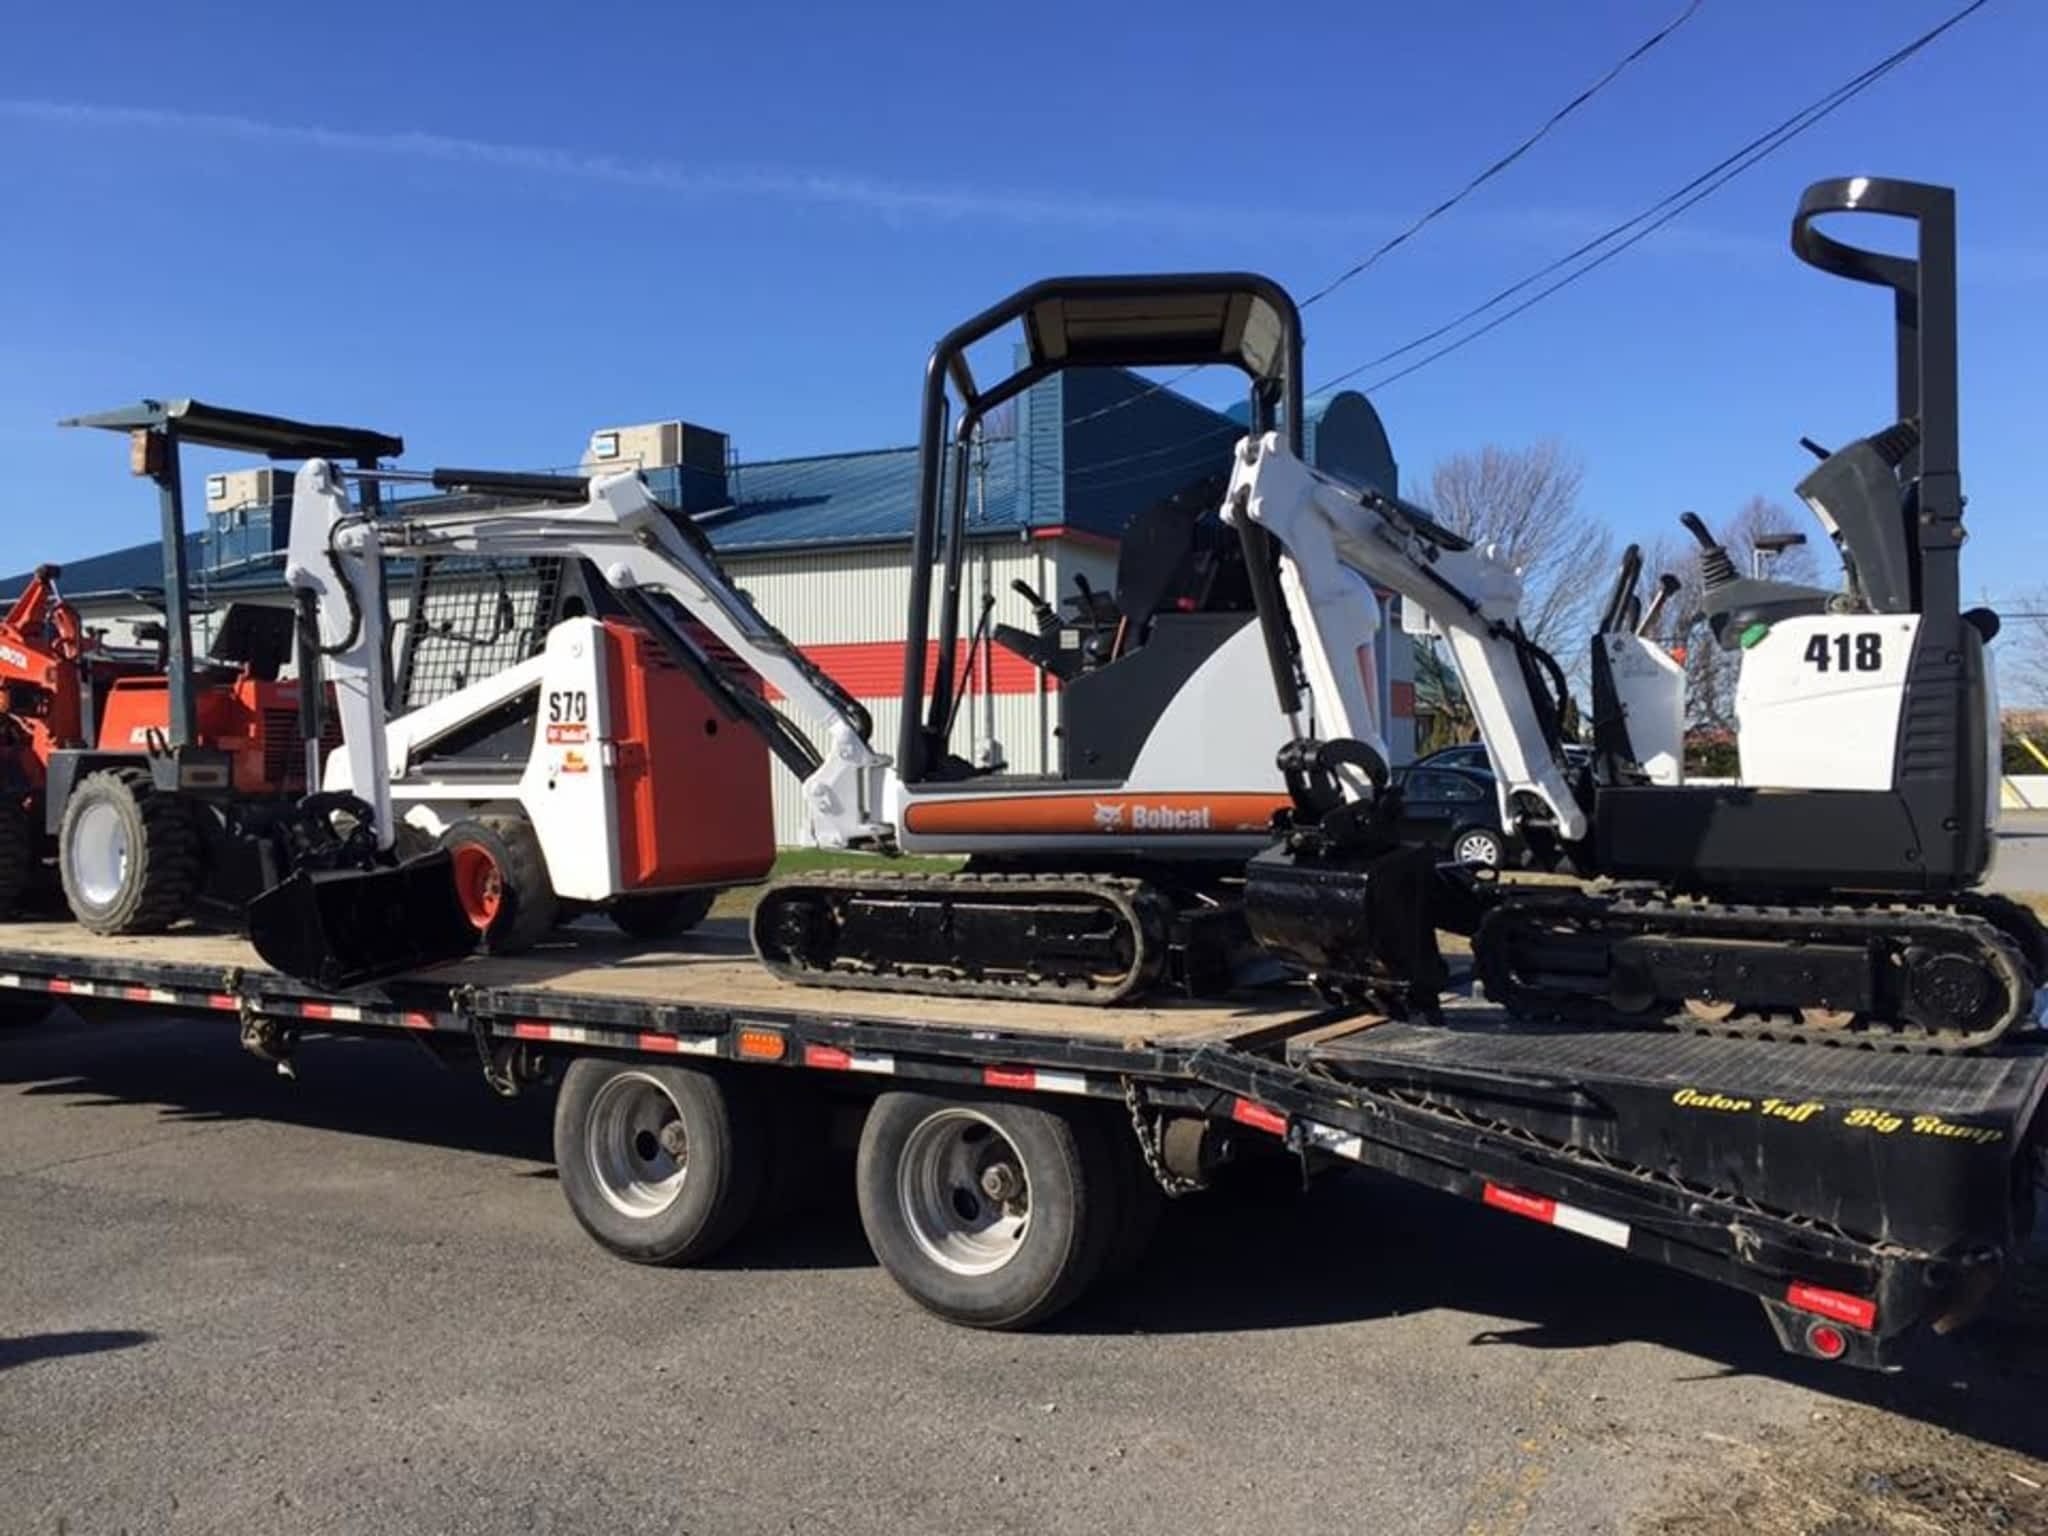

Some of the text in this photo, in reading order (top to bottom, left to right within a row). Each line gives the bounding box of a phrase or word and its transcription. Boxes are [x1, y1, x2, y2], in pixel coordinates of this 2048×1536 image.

[1804, 633, 1882, 672] 418
[549, 691, 587, 722] S70
[1131, 804, 1211, 829] Bobcat
[1672, 1087, 2004, 1144] Gator Tuff Big Ramp
